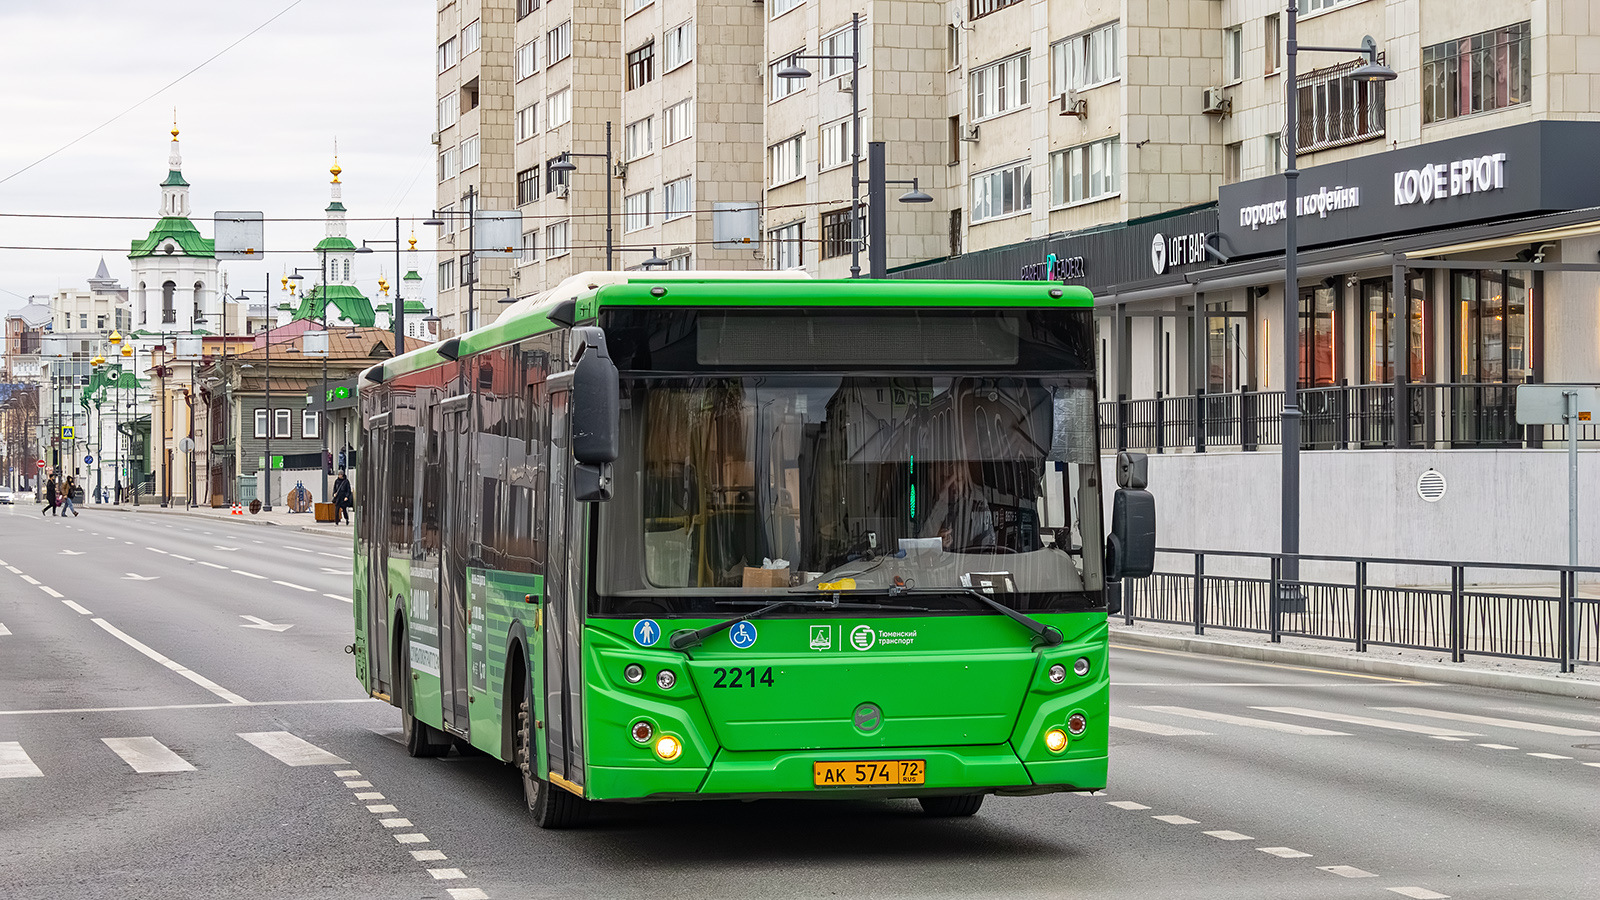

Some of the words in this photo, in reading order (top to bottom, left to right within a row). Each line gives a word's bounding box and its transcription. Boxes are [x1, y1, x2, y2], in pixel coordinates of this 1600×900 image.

[1394, 163, 1447, 205] КОФЕ
[1450, 153, 1506, 196] БРЮТ
[1240, 197, 1303, 230] городск
[1303, 186, 1359, 218] кофейня
[1168, 235, 1188, 266] LOFT
[1189, 232, 1206, 262] BAR
[879, 630, 917, 638] Тюменский
[879, 638, 914, 646] транспорт
[713, 667, 774, 688] 2214
[824, 769, 846, 782] АК
[856, 764, 889, 782] 574
[901, 762, 918, 776] 72
